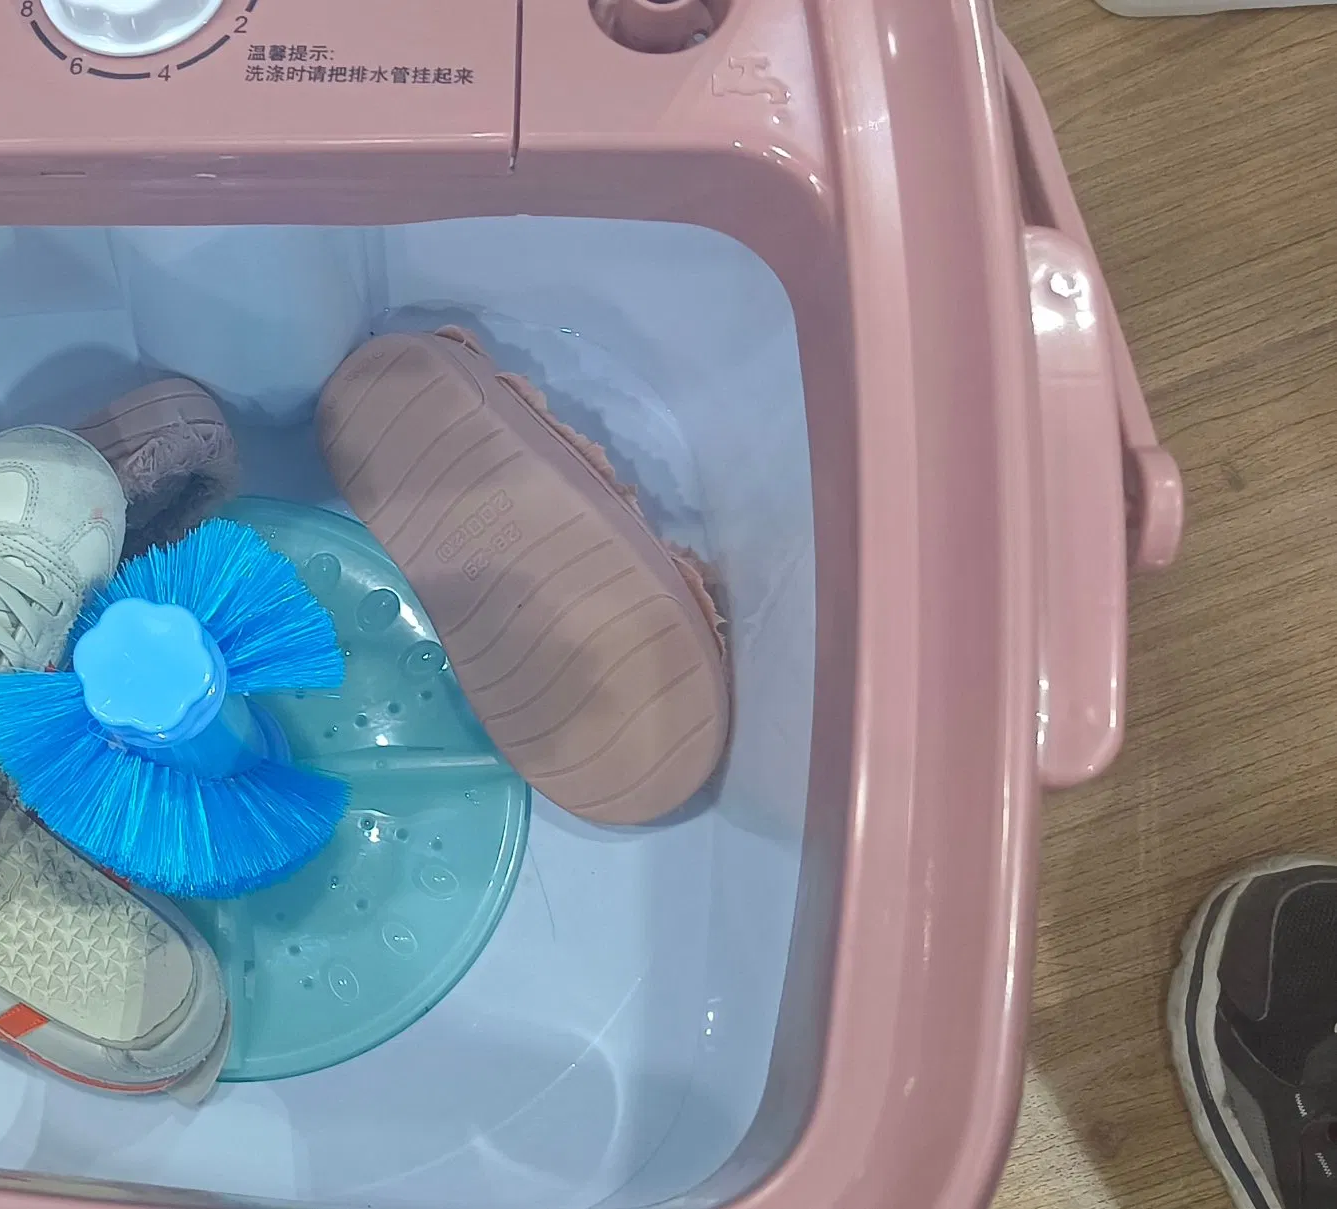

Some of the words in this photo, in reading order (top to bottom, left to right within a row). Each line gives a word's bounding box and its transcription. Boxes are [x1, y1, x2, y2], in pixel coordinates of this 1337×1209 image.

[20, 1, 33, 18] 8
[233, 15, 248, 34] 2
[247, 44, 334, 62] 温馨提示:
[69, 57, 83, 75] 6
[157, 64, 171, 82] 4
[245, 65, 474, 84] 洗涤时请把排水管挂起来
